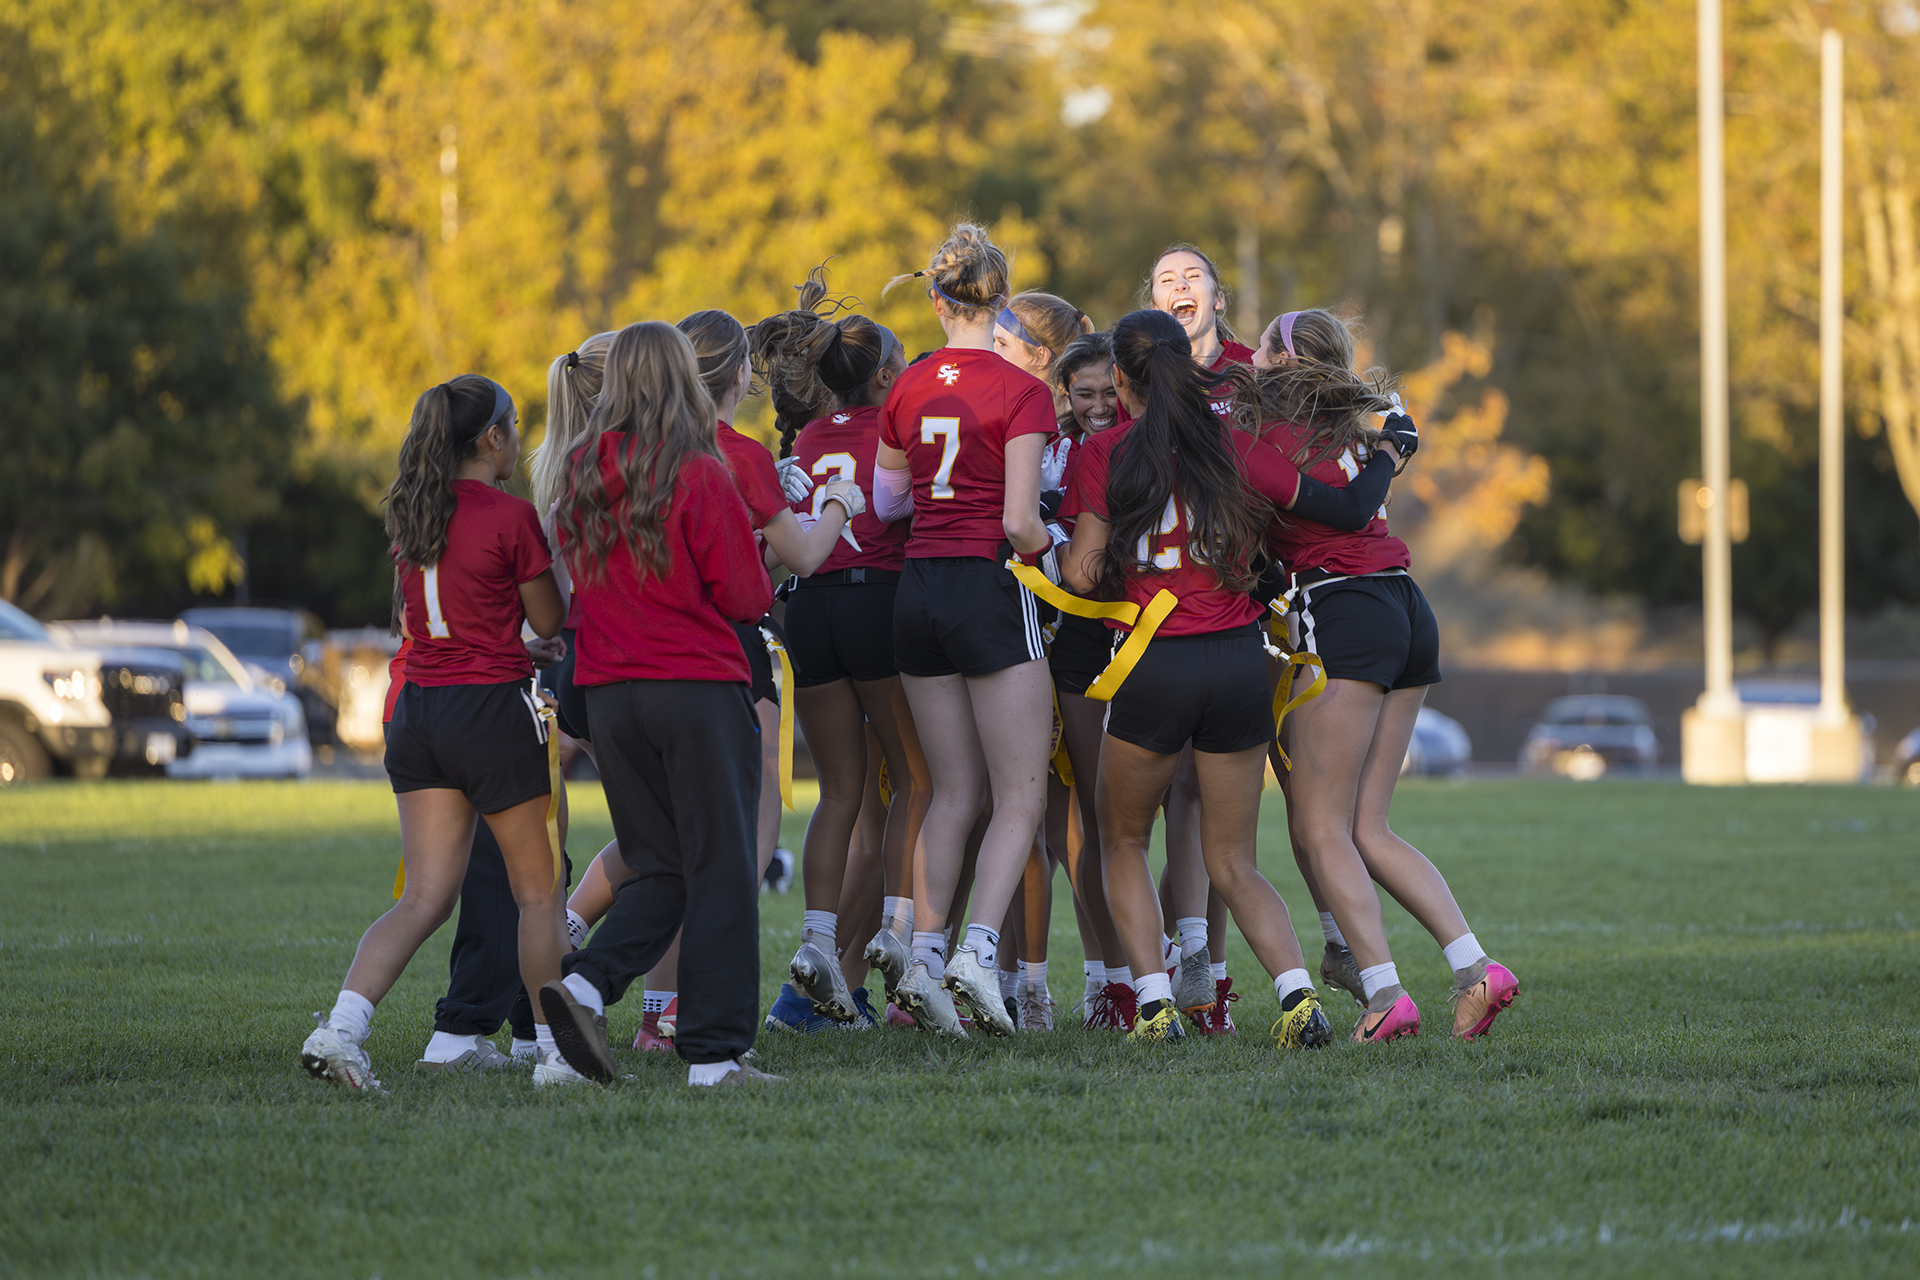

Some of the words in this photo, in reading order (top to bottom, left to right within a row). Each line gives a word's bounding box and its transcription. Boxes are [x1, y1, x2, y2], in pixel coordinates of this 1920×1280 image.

[936, 363, 961, 386] SF
[812, 452, 857, 529] 2
[920, 416, 961, 499] 7
[420, 562, 451, 639] 1
